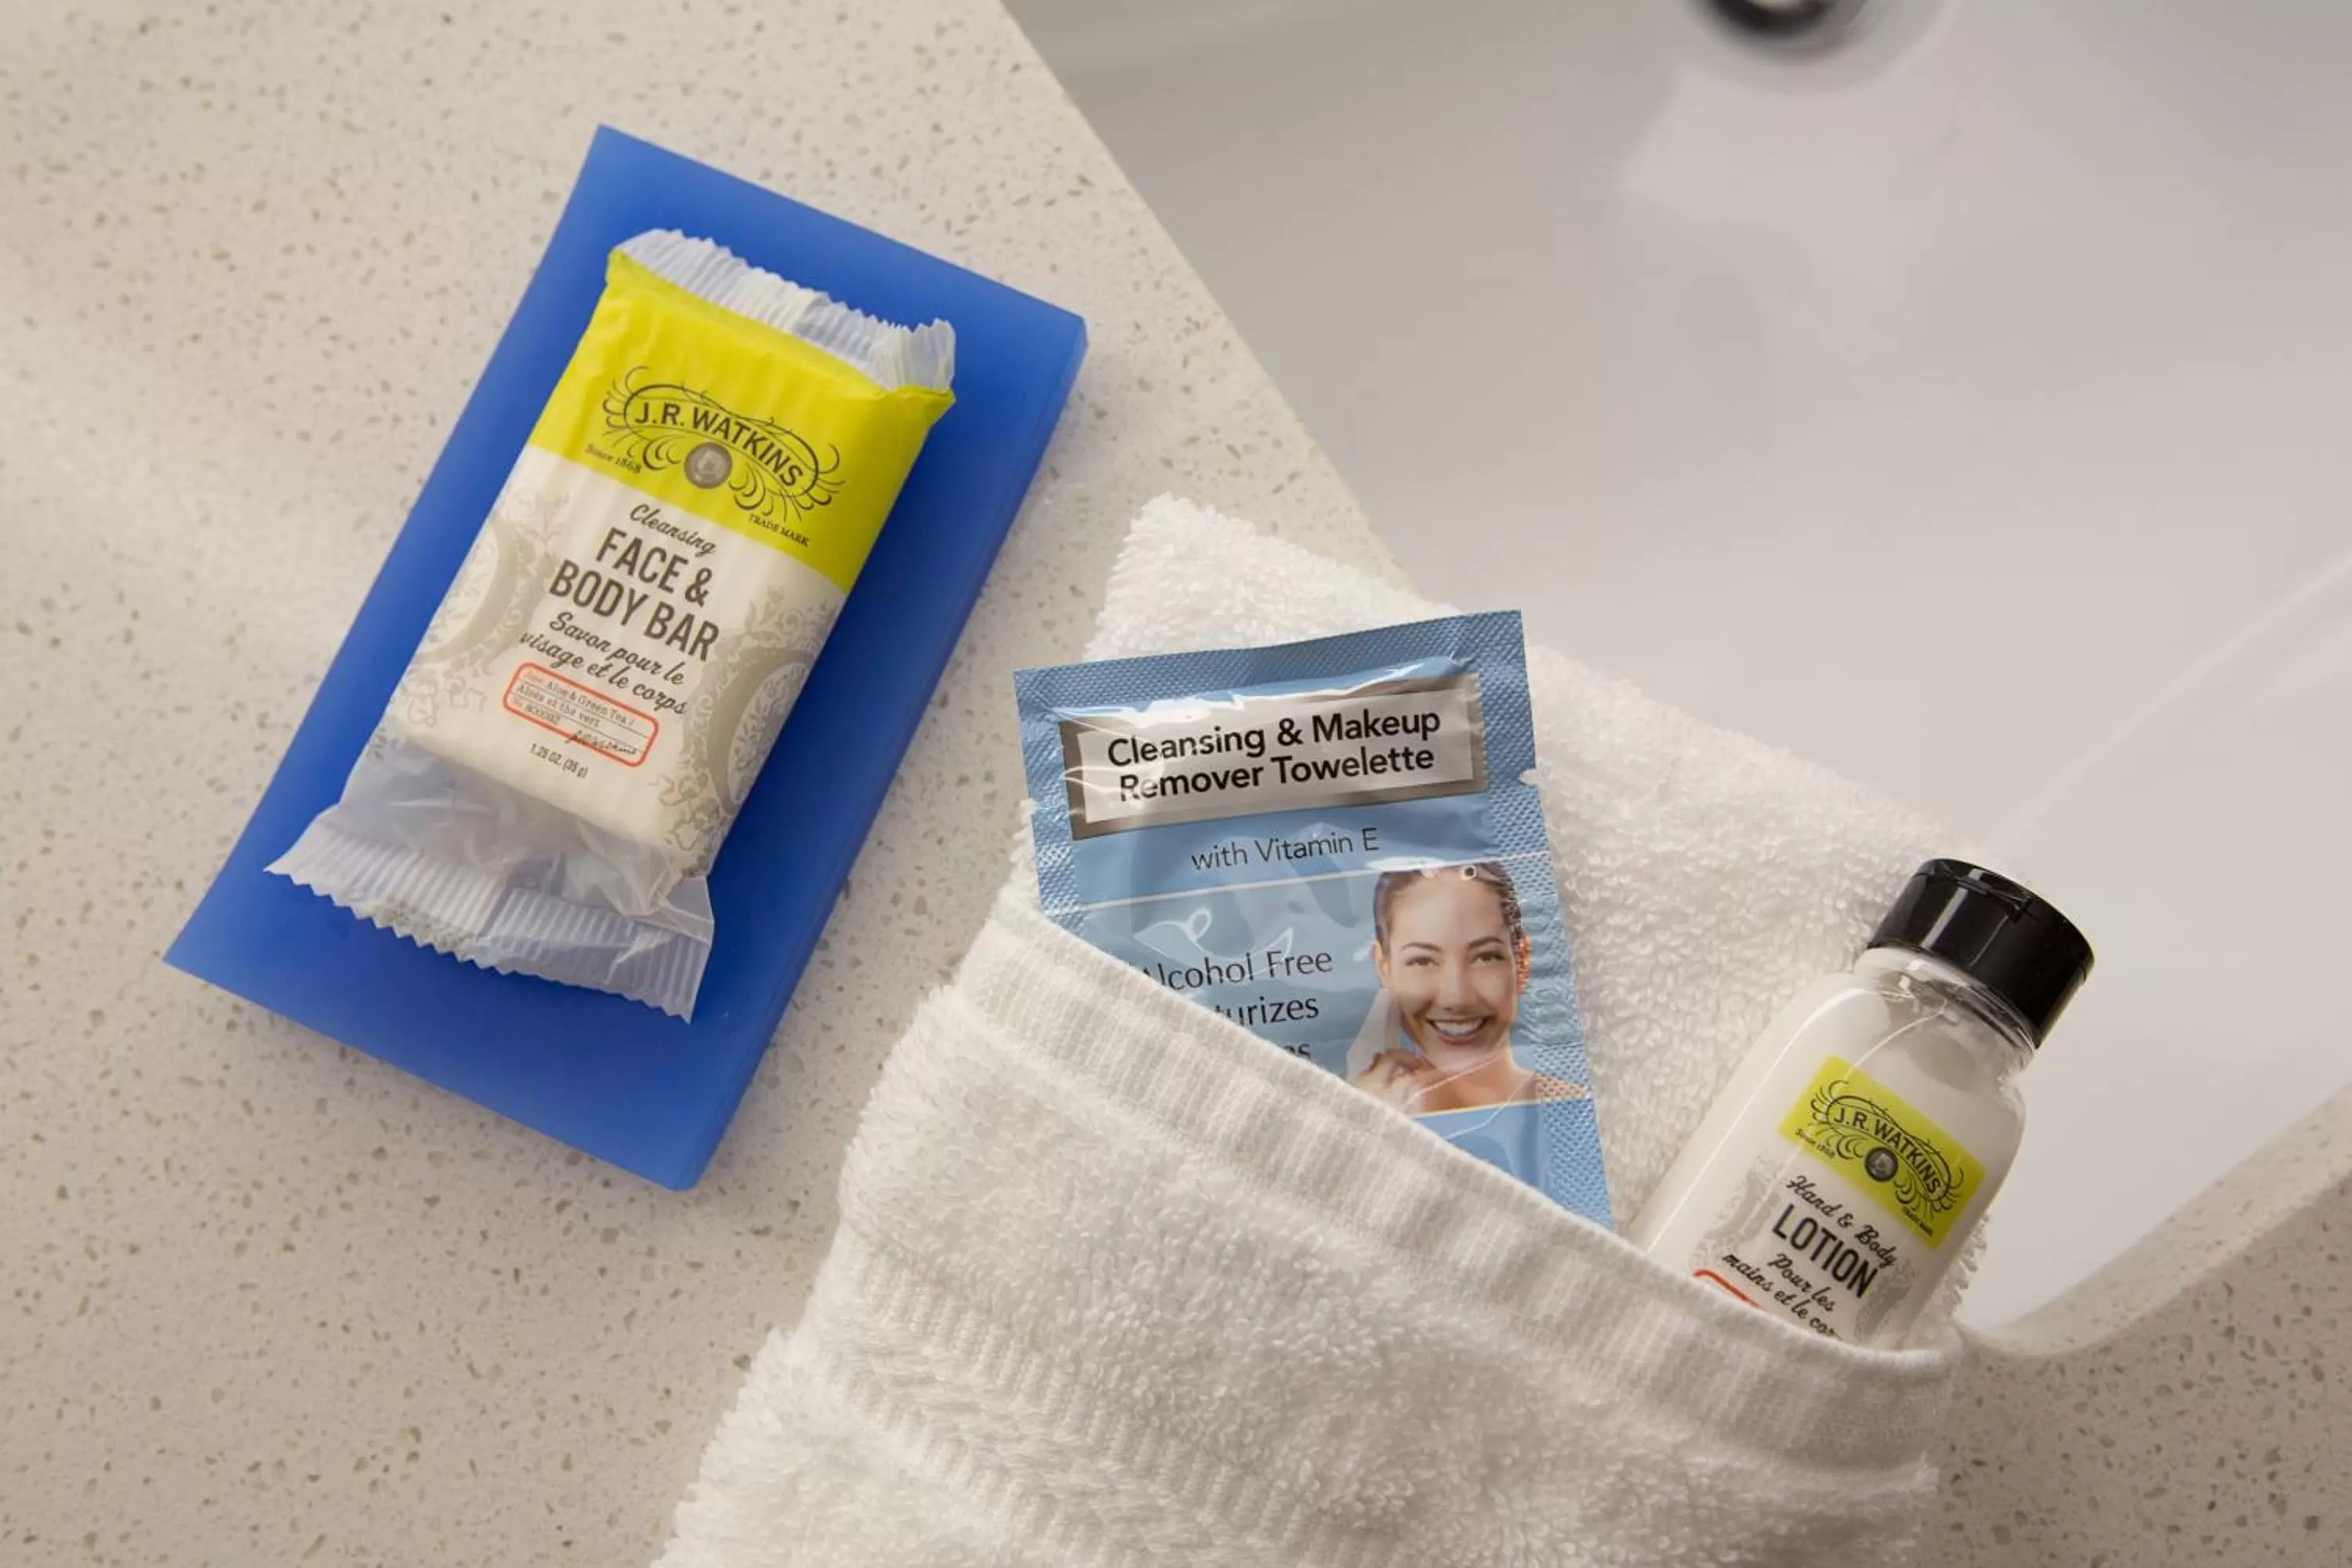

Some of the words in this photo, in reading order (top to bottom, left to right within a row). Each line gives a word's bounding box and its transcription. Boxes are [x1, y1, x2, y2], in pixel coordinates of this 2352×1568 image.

[635, 402, 685, 427] J.R.
[691, 406, 804, 488] WATKINS
[630, 503, 717, 557] Cleansing
[595, 527, 688, 593] FACE
[684, 567, 713, 608] &
[550, 559, 648, 627] BODY
[643, 601, 720, 662] BAR
[519, 631, 585, 670] visage
[587, 660, 613, 679] et
[608, 666, 630, 689] le
[632, 681, 688, 716] corps
[550, 611, 611, 654] Savon
[605, 646, 664, 676] pour
[663, 662, 684, 686] le
[1107, 725, 1265, 768] Cleansing
[1277, 717, 1303, 747] &
[1312, 708, 1441, 742] Makeup
[1119, 764, 1265, 803] Remover
[1271, 744, 1436, 785] Towelette
[1191, 837, 1248, 872] with
[1254, 829, 1353, 863] Vitamin
[1361, 827, 1380, 853] E
[1142, 952, 1254, 991] lcohol
[1266, 949, 1334, 978] Free
[1215, 995, 1320, 1027] urizes
[1833, 1106, 1870, 1132] J.R.
[1874, 1119, 1942, 1196] WATKINS
[1772, 1203, 1879, 1300] LOTION
[1787, 1175, 1842, 1218] Hand
[1837, 1213, 1855, 1230] &
[1854, 1223, 1899, 1270] Body
[1722, 1254, 1773, 1293] mains
[1774, 1290, 1797, 1307] et
[1791, 1299, 1811, 1319] le
[1811, 1287, 1836, 1313] les
